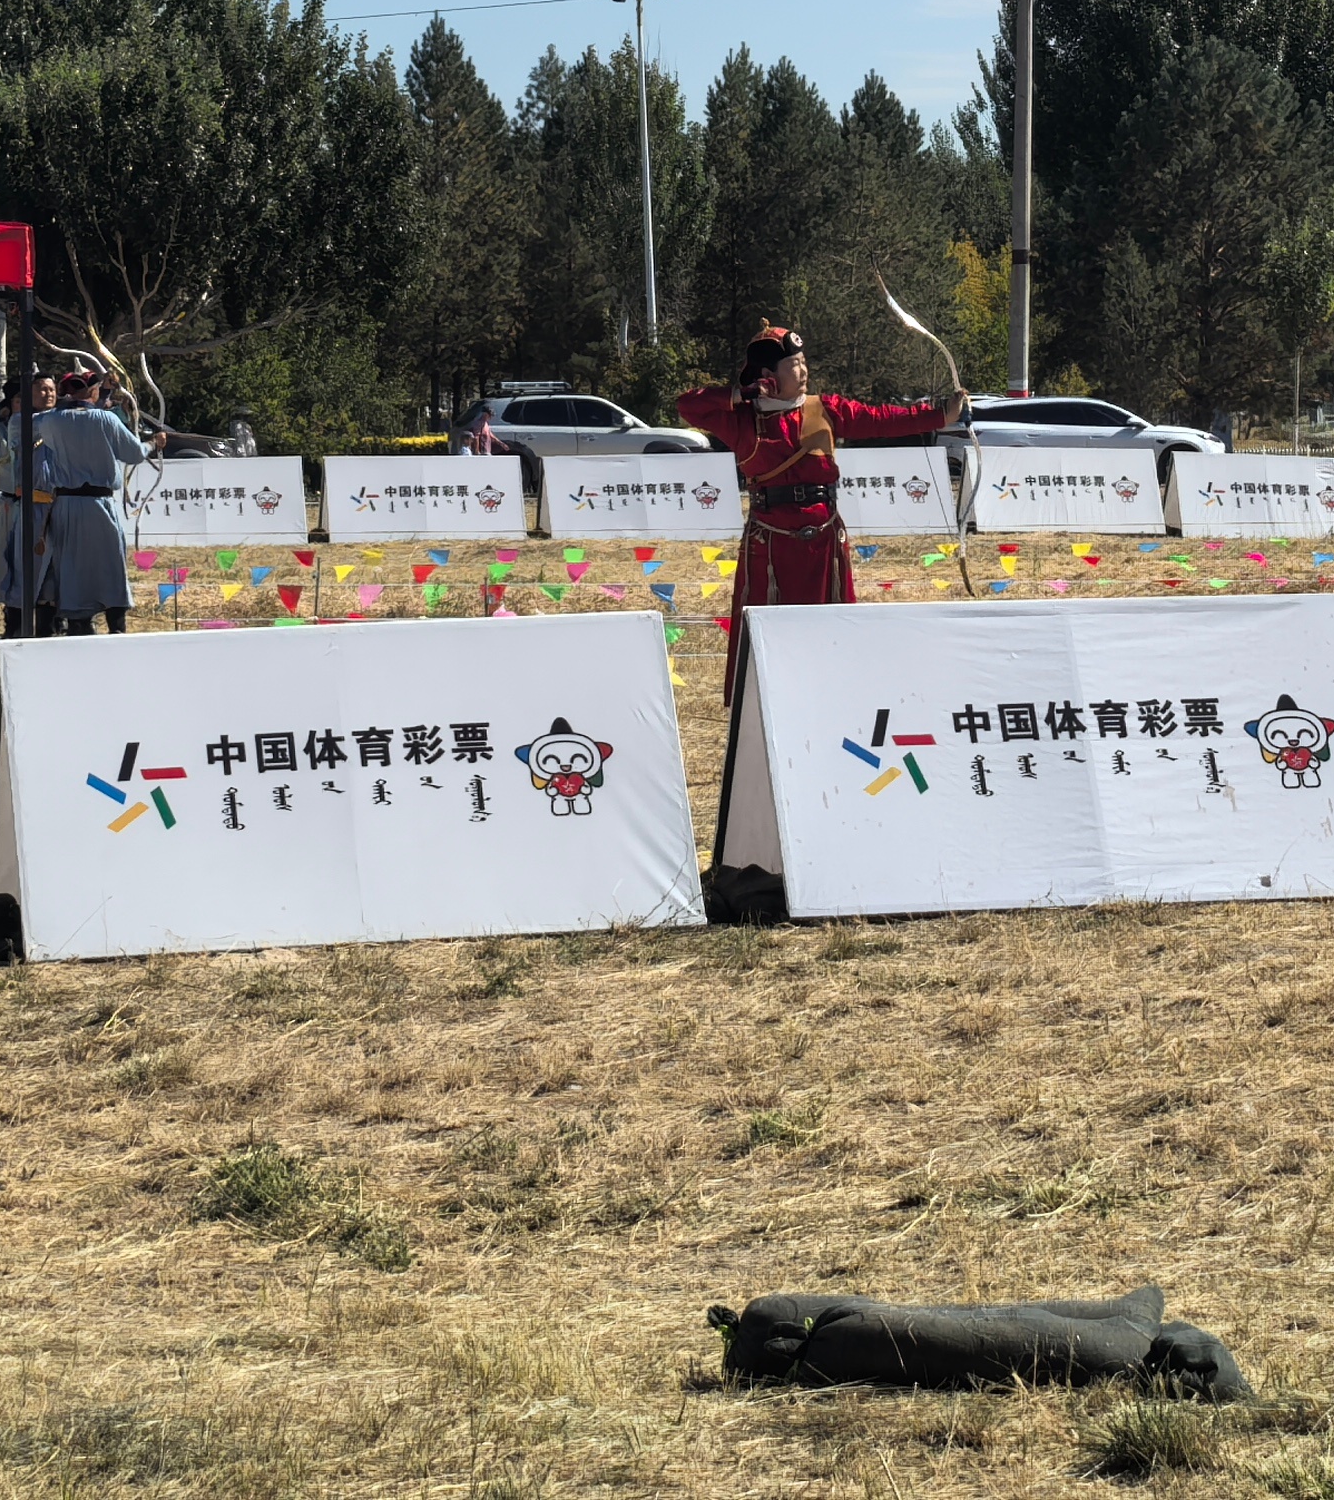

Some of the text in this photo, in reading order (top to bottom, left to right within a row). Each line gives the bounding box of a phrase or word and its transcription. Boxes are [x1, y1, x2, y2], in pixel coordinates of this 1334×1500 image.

[837, 476, 896, 489] 体育彩票
[1025, 475, 1105, 487] 中国体育彩票
[159, 486, 246, 500] 中国体育彩票
[385, 485, 469, 498] 中国体育彩票
[602, 483, 685, 496] 中国体育彩票
[1230, 482, 1310, 496] 中国体育彩票
[952, 698, 1224, 744] 中国体育彩票
[206, 722, 494, 776] 中国体育彩票
